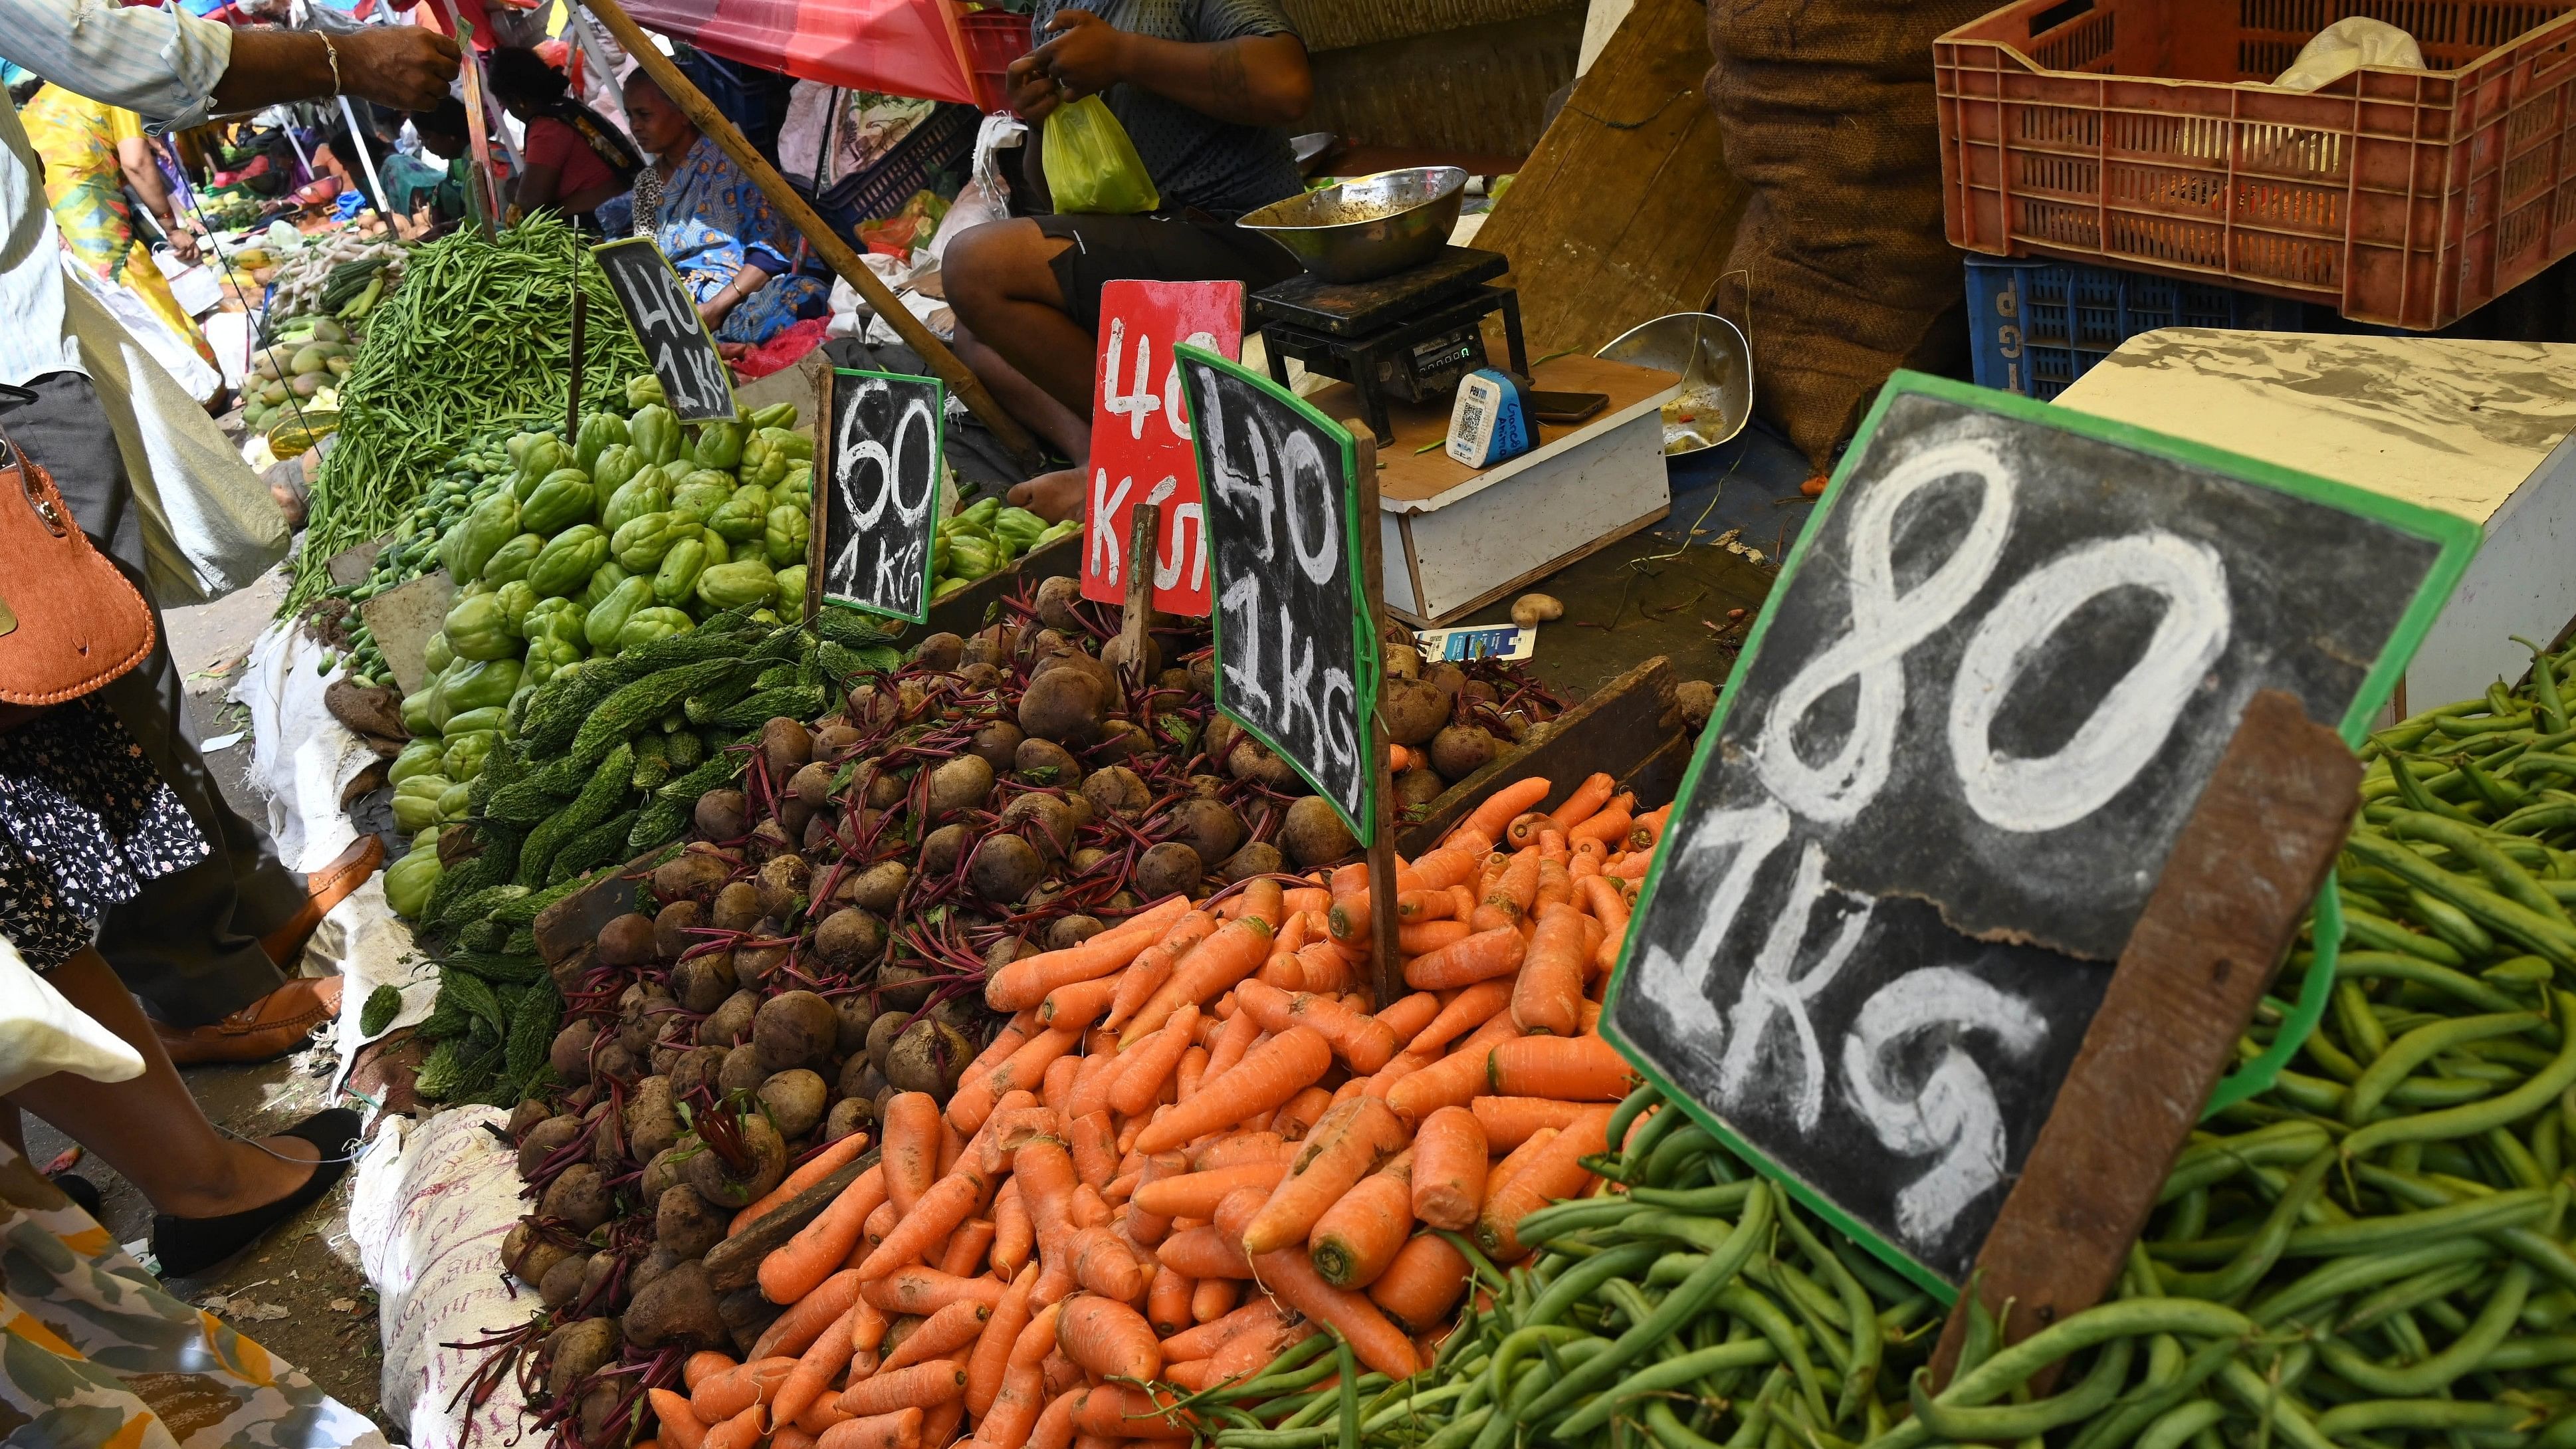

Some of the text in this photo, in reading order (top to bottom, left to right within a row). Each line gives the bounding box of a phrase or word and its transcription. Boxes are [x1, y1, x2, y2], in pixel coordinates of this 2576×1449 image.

[612, 255, 698, 340] 40
[835, 378, 936, 532] 60
[1104, 316, 1222, 440] 40
[1198, 366, 1338, 585] 40
[1756, 437, 2233, 833] 80
